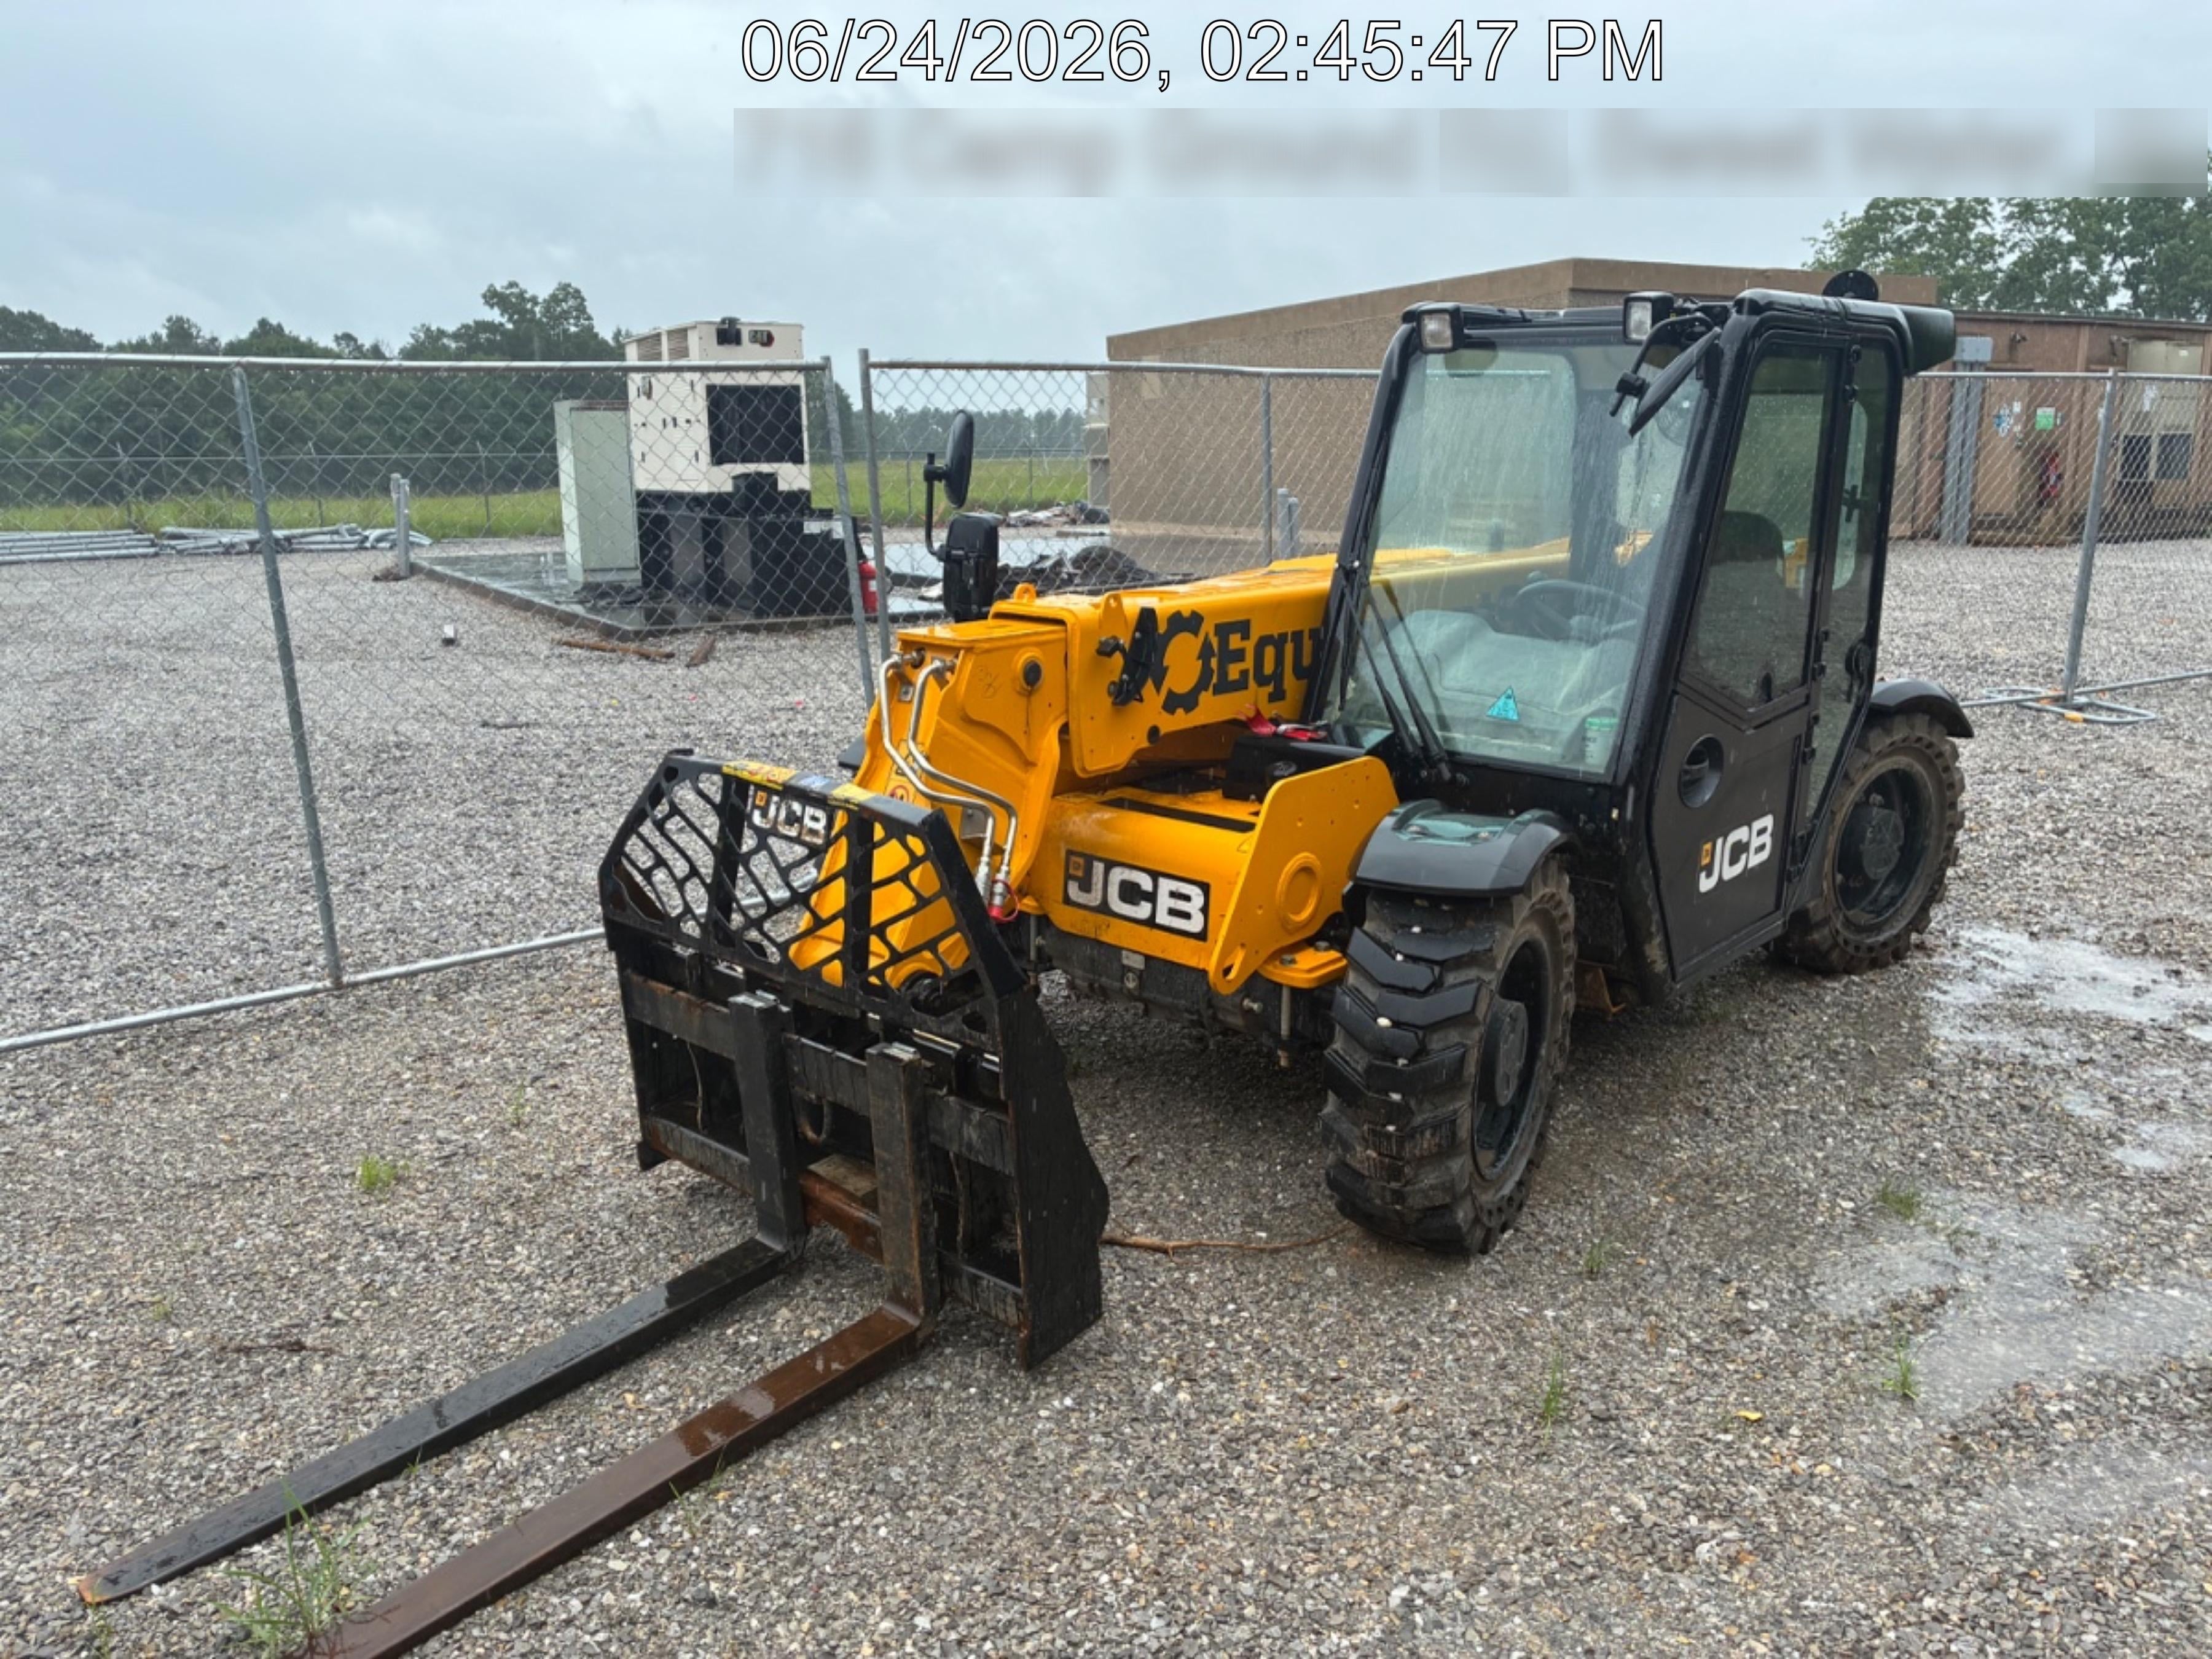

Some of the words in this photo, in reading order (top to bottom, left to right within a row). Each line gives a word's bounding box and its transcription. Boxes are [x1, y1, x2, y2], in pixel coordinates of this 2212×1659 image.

[752, 794, 826, 845] JCB
[1699, 813, 1774, 893] JCB
[1067, 860, 1204, 933] JCB
